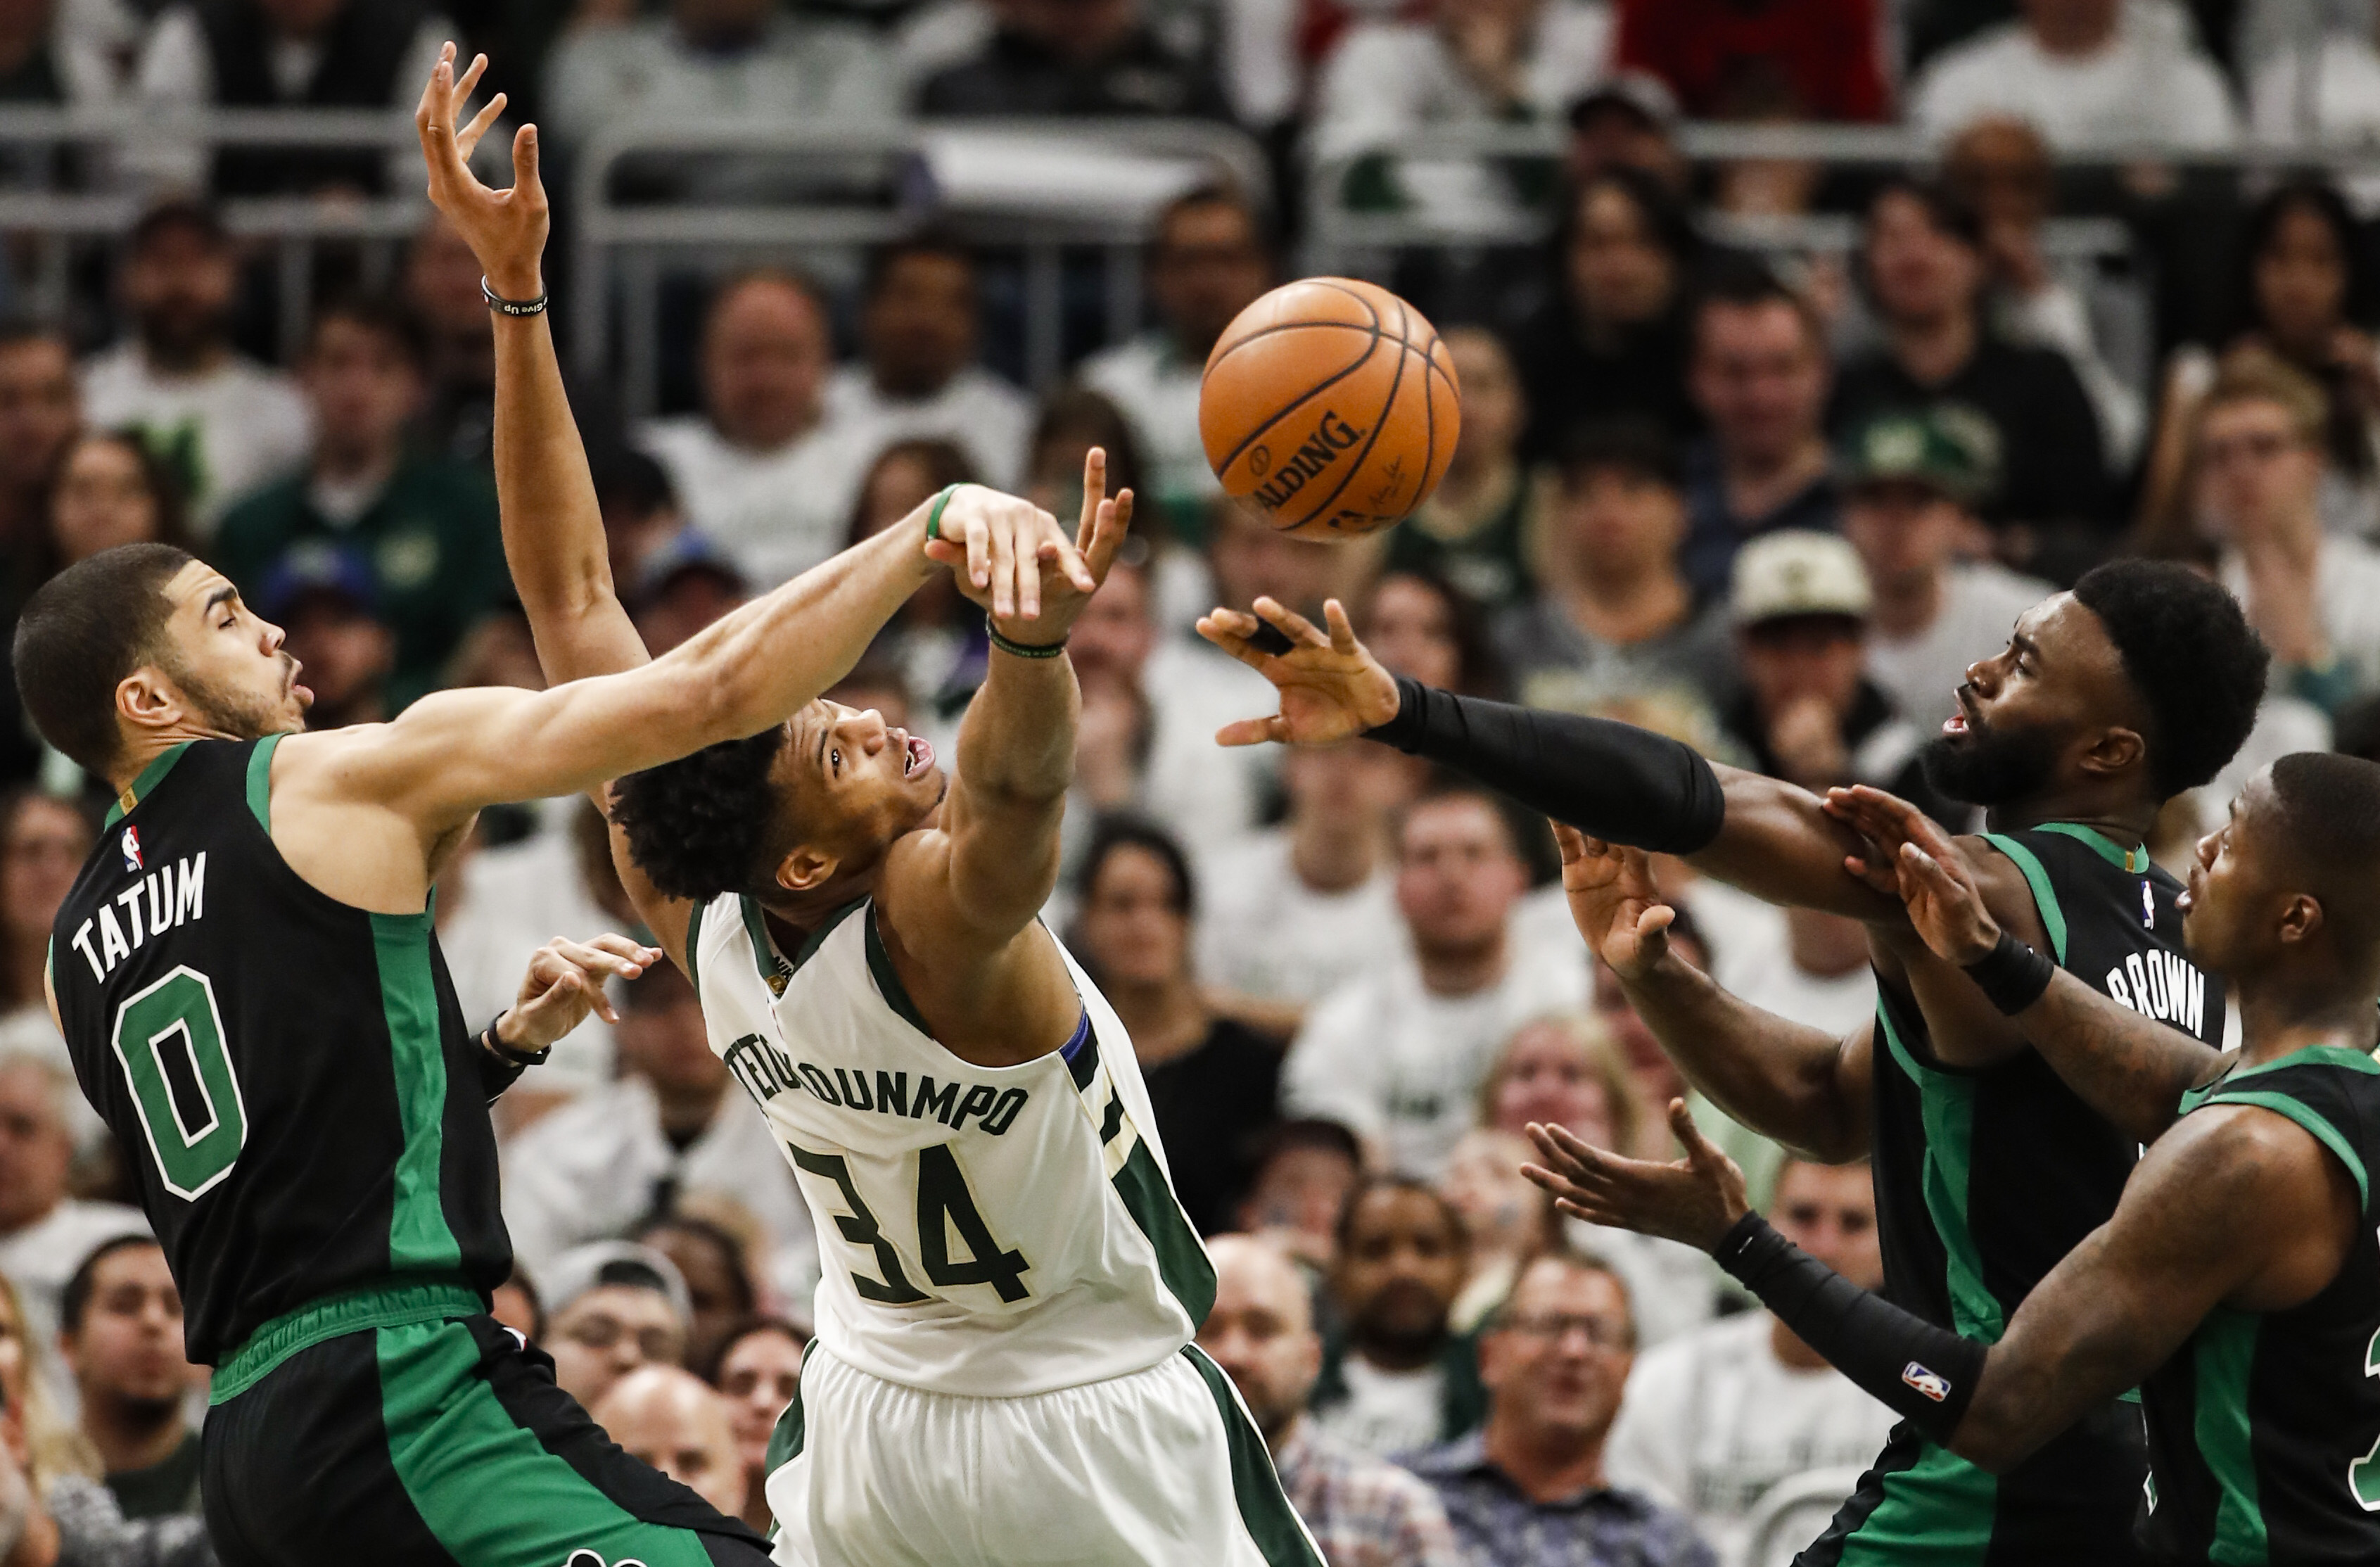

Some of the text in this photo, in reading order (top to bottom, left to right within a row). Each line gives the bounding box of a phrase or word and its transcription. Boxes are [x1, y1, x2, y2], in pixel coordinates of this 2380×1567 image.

[504, 303, 543, 314] Give Up
[72, 851, 207, 984] TATUM
[112, 965, 248, 1203] 0
[787, 1141, 1030, 1303] 34
